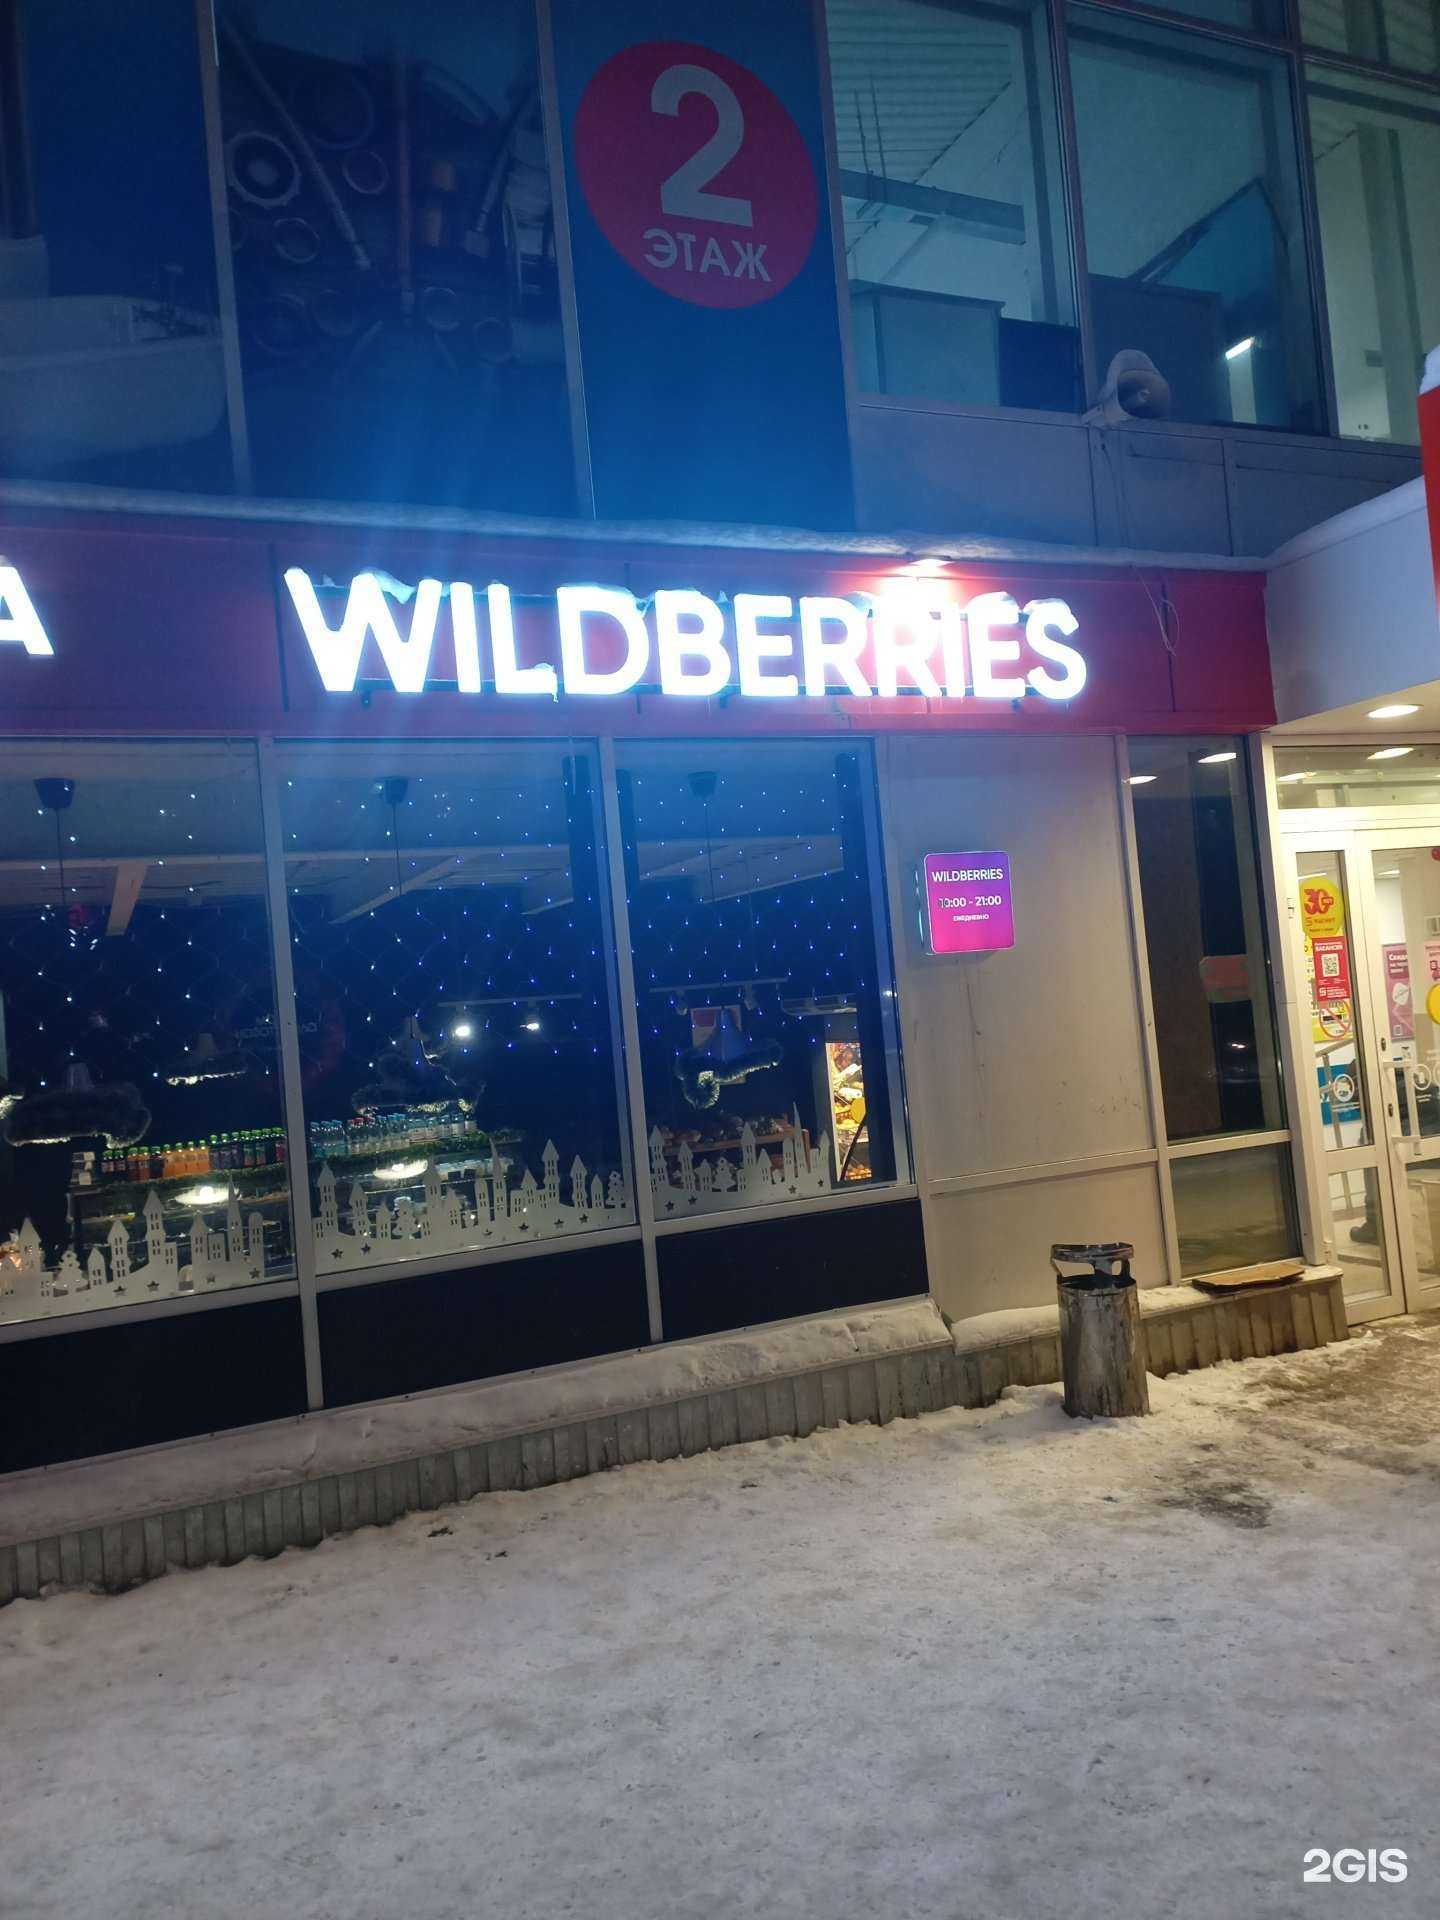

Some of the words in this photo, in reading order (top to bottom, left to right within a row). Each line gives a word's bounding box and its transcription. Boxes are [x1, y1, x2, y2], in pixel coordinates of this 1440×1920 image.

[651, 64, 753, 227] 2
[642, 228, 772, 282] ЭТАЖ
[284, 567, 1087, 700] WILDBERRIES
[931, 868, 1004, 882] WILDBERRIES
[975, 895, 1002, 906] 21:00
